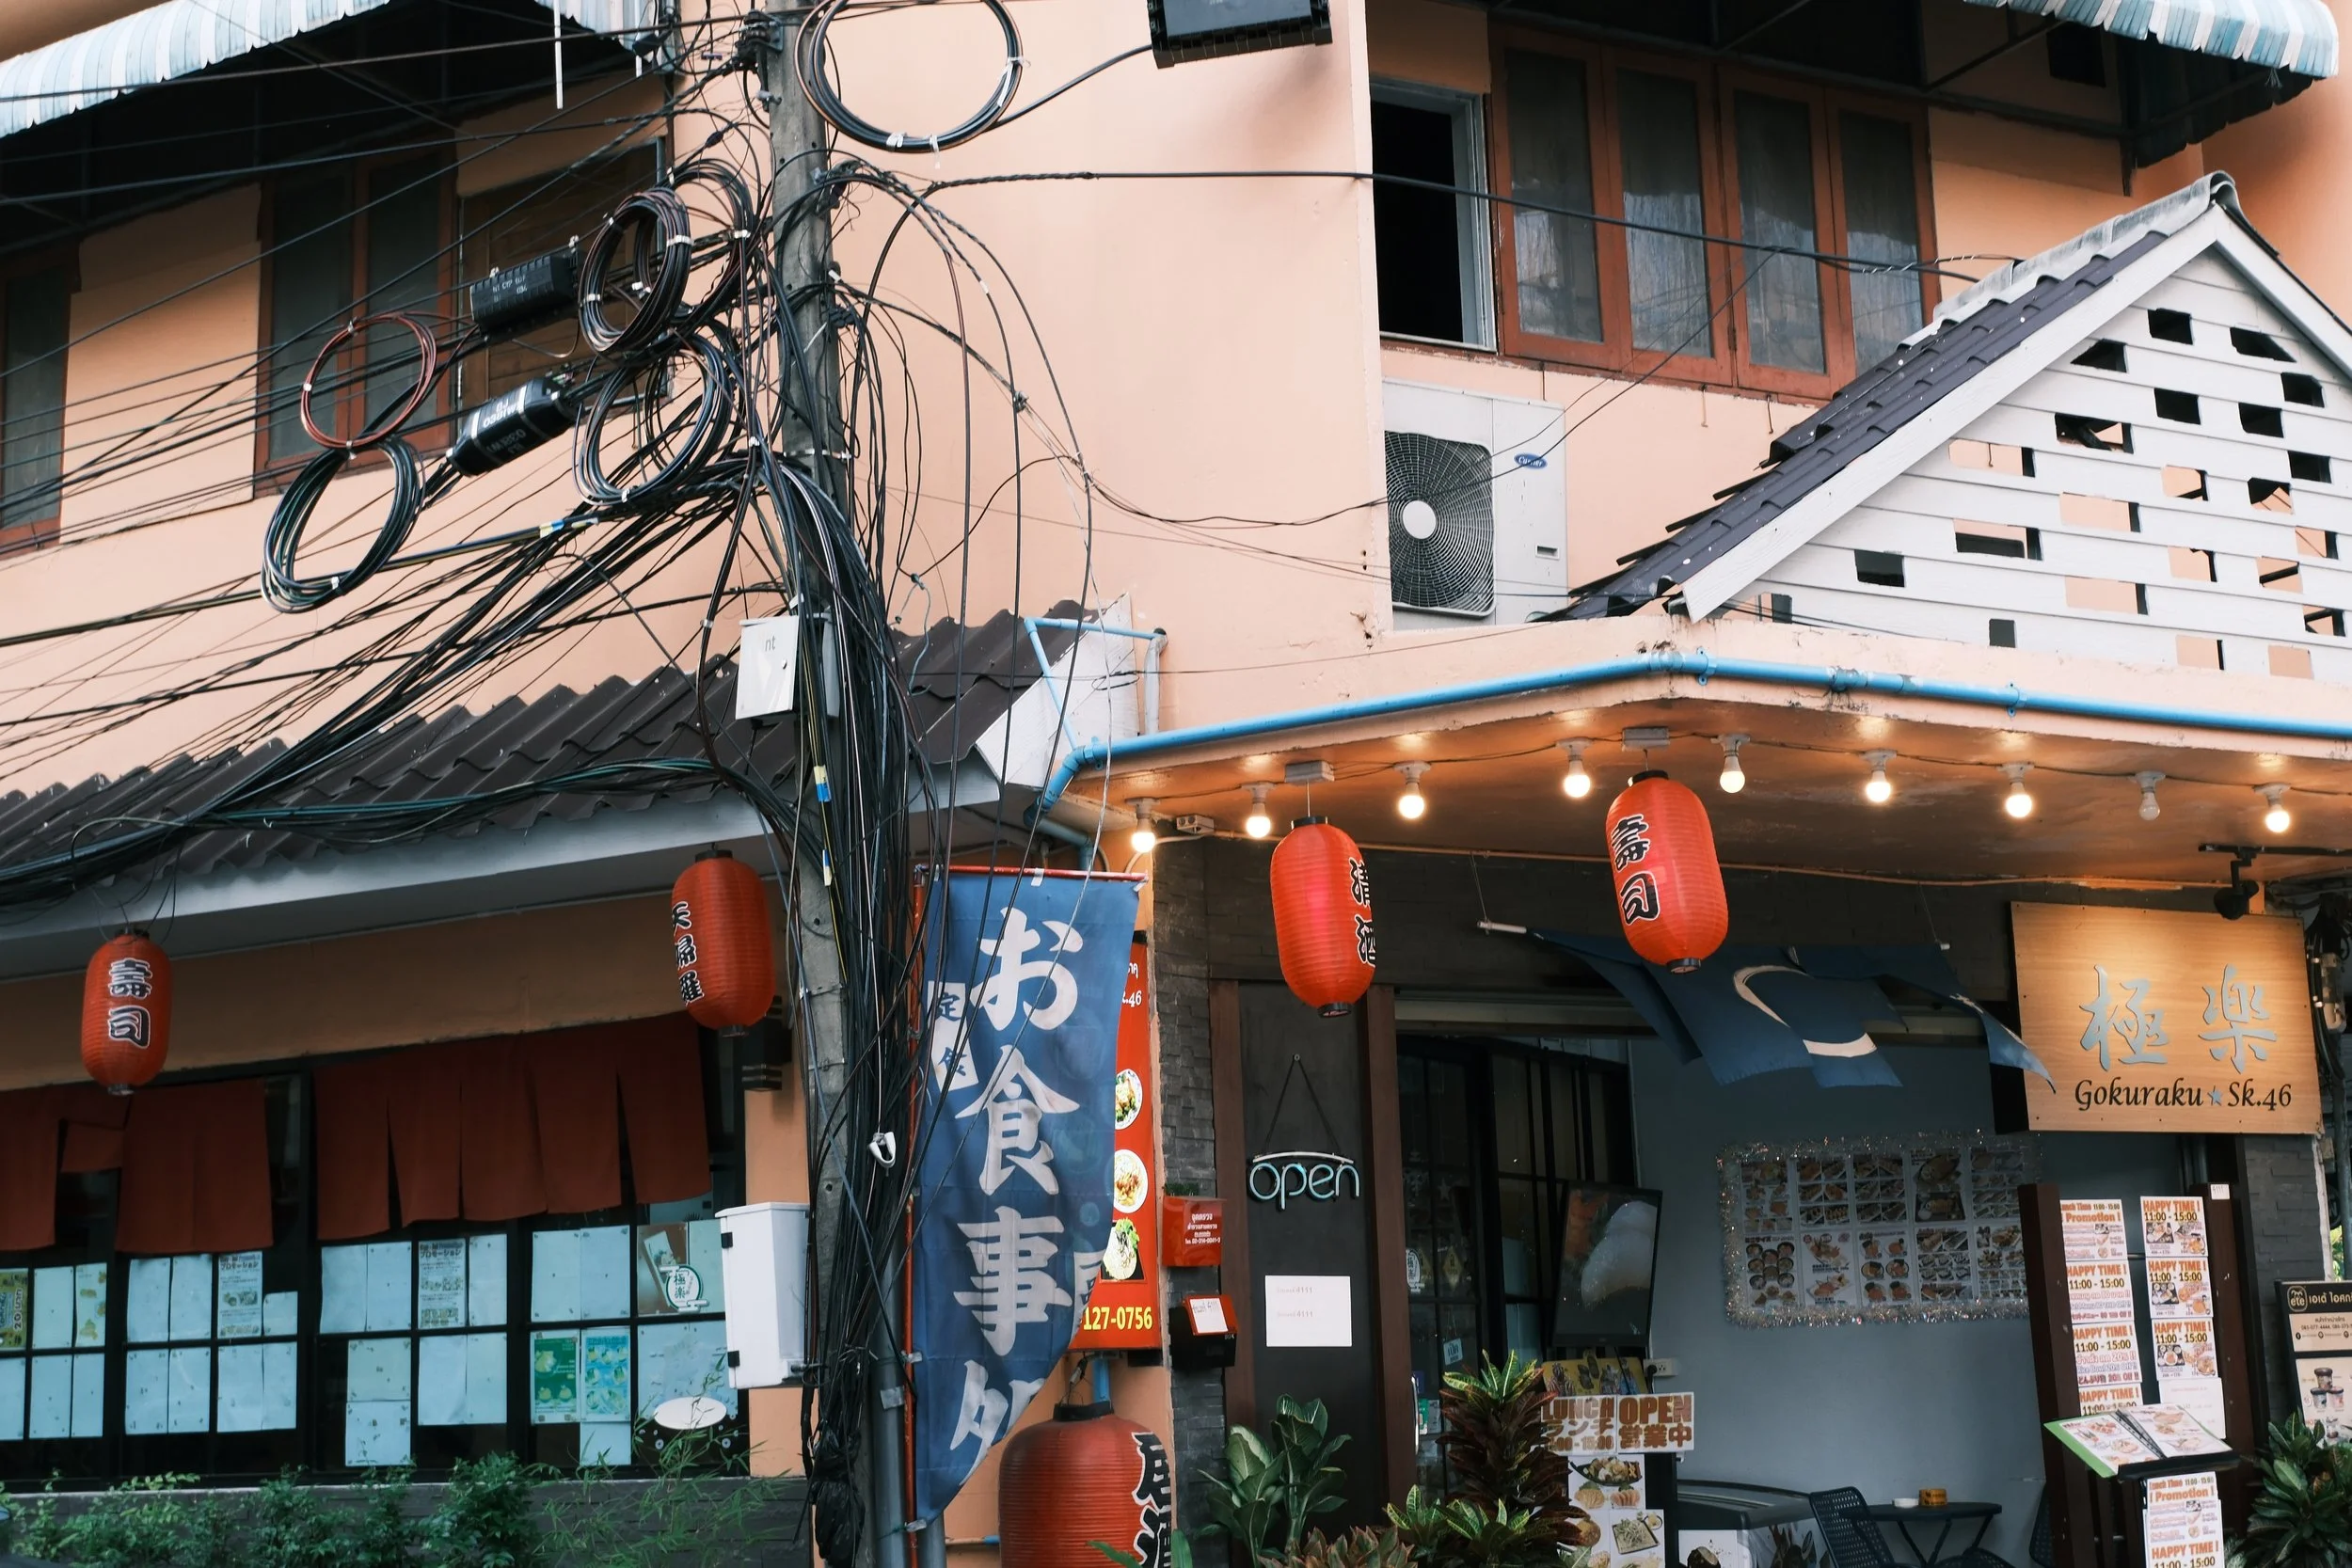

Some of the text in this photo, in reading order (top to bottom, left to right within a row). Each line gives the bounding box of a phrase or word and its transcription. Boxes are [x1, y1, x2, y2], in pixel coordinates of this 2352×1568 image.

[765, 635, 776, 651] nt
[2079, 963, 2277, 1074] 極楽
[2074, 1077, 2292, 1112] Gokuraku Sk.46
[1249, 1163, 1360, 1210] open
[2143, 1200, 2170, 1212] HAPPY
[2173, 1200, 2195, 1212] TIME
[2066, 1212, 2115, 1223] Promotion
[2144, 1212, 2167, 1222] 11:00
[2174, 1212, 2198, 1222] 15:00
[2066, 1265, 2096, 1276] HAPPY
[2098, 1264, 2122, 1275] TIME
[2148, 1260, 2176, 1272] HAPPY
[2179, 1260, 2201, 1271] TIME
[2069, 1279, 2092, 1290] 11:00
[2100, 1277, 2124, 1288] 15:00
[2150, 1273, 2171, 1282] 11:00
[2179, 1272, 2202, 1281] 15:00
[2290, 1296, 2305, 1307] ete
[2329, 1291, 2352, 1304] ไอศก
[1084, 1307, 1153, 1331] 127-0756
[2073, 1328, 2102, 1339] HAPPY
[2104, 1326, 2127, 1338] TIME
[2154, 1323, 2182, 1334] HAPPY
[2185, 1322, 2207, 1333] TIME
[2155, 1334, 2177, 1344] 11:00
[2185, 1333, 2207, 1343] 15:00
[2075, 1341, 2099, 1353] 11:00
[2107, 1339, 2131, 1351] 15:00
[2080, 1390, 2108, 1402] HAPPY
[2109, 1388, 2134, 1401] TIME
[1542, 1397, 1615, 1421] LUNCH
[1618, 1395, 1692, 1425] OPEN
[1546, 1418, 1614, 1438] ランチ
[1618, 1422, 1692, 1449] 営業中
[2150, 1481, 2166, 1491] Lunch
[2168, 1480, 2183, 1488] Time
[2155, 1488, 2208, 1502] Promotion
[2152, 1545, 2186, 1560] HAPPY
[2188, 1542, 2214, 1556] TIME
[2190, 1557, 2216, 1568] 15:00
